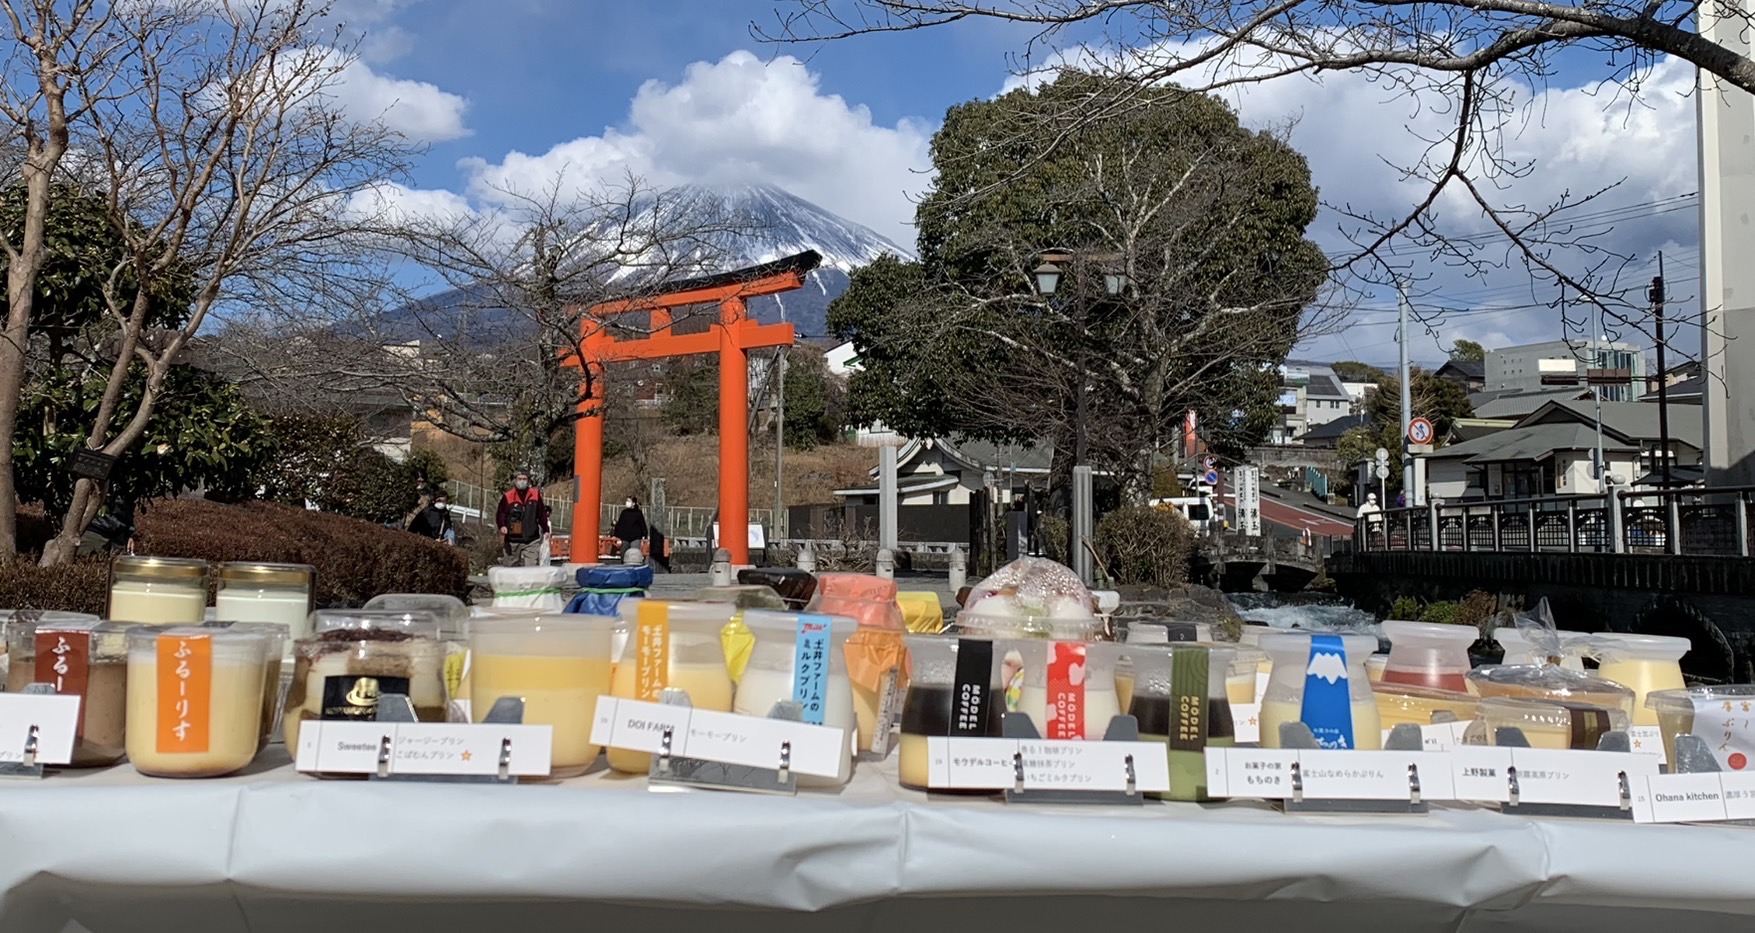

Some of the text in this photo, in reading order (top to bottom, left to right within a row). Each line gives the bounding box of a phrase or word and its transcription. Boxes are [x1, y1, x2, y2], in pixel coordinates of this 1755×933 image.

[51, 636, 71, 692] ふるー
[640, 624, 651, 698] モーモープリン
[172, 640, 192, 742] ふるーりす
[959, 683, 971, 730] COFFEE
[968, 684, 981, 730] MODEL
[627, 719, 646, 730] DOI
[1057, 692, 1067, 738] COFFEE
[1067, 692, 1076, 738] MODEL
[1179, 695, 1190, 740] COFFEE
[1189, 695, 1200, 740] MODEL
[1247, 775, 1281, 785] もちのき
[1655, 792, 1720, 802] Ohana kitchen
